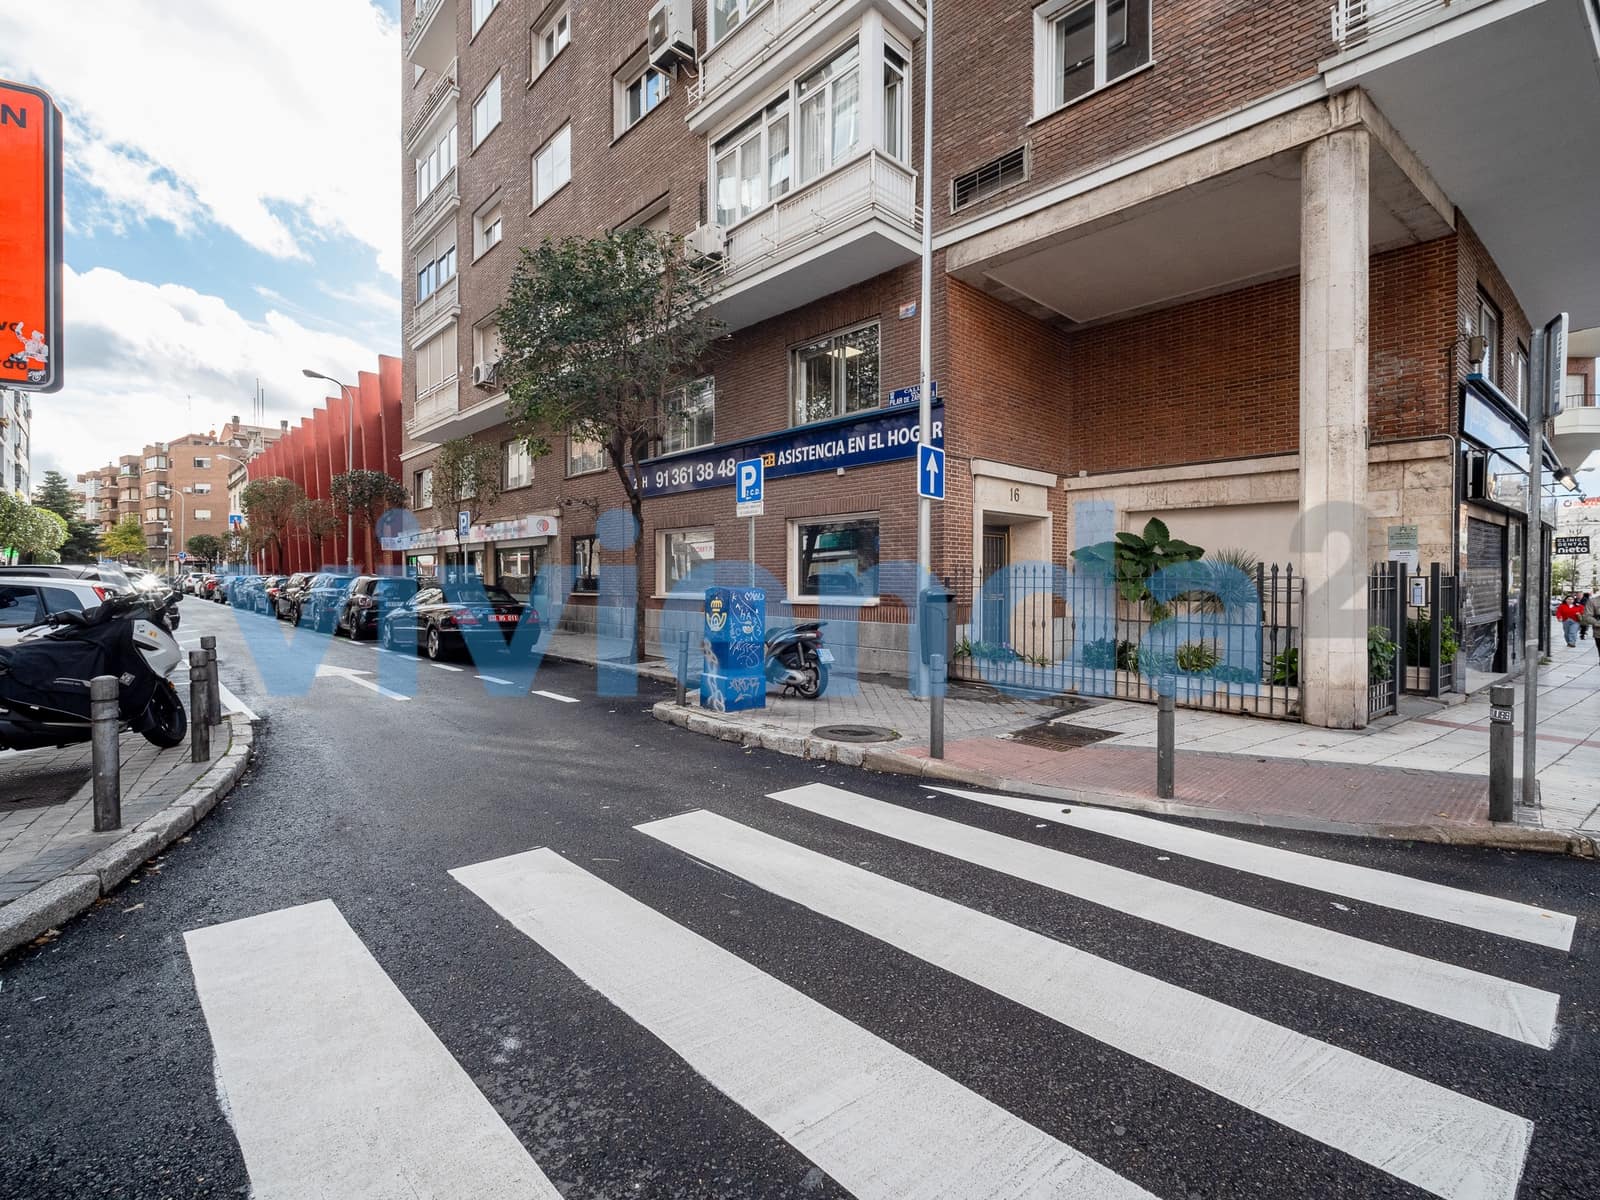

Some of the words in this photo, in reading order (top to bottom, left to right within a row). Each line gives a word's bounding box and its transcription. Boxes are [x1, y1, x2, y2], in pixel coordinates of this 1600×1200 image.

[778, 439, 845, 466] ASISTENCIA
[848, 435, 865, 454] EN
[869, 432, 884, 450] EL
[887, 421, 943, 446] HOGR
[642, 475, 648, 488] H
[656, 470, 669, 488] 91
[671, 465, 693, 486] 361
[696, 462, 714, 481] 38
[717, 458, 736, 477] 48
[741, 465, 757, 498] P
[1010, 487, 1020, 502] 16
